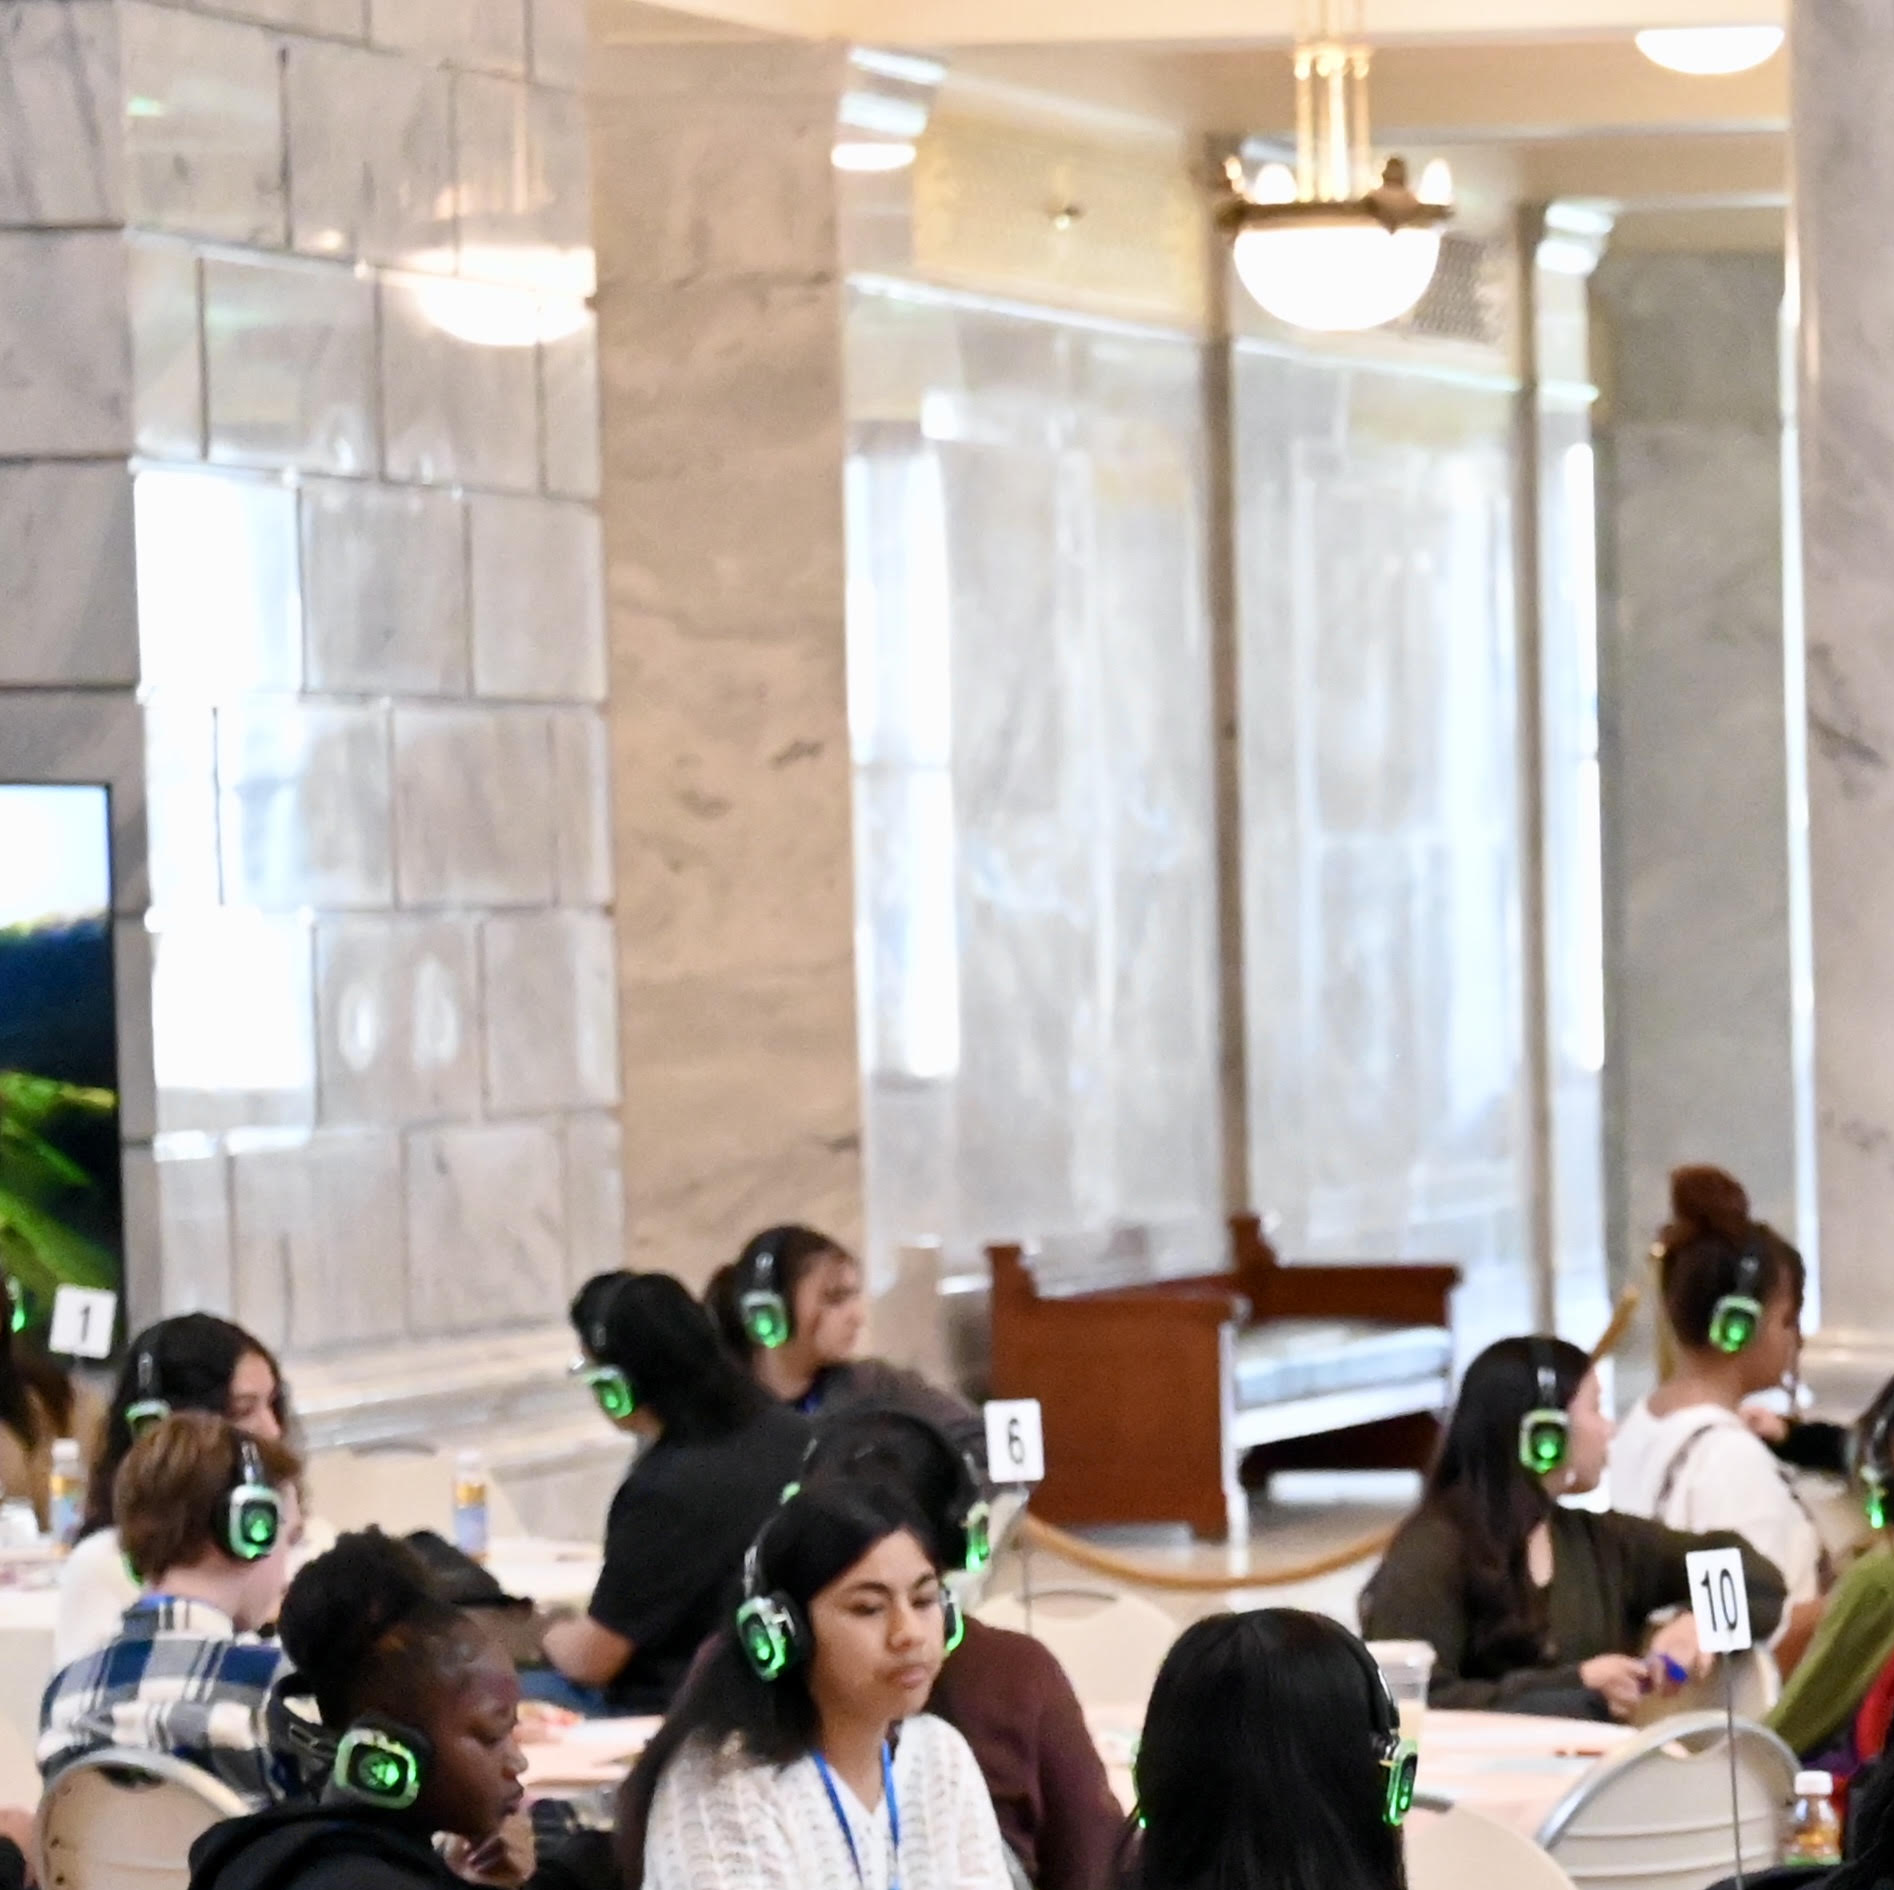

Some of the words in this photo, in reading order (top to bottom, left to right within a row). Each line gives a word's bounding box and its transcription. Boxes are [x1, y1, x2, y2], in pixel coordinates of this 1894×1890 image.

[80, 1304, 91, 1343] 1
[1007, 1417, 1025, 1464] 6
[1701, 1568, 1737, 1632] 10
